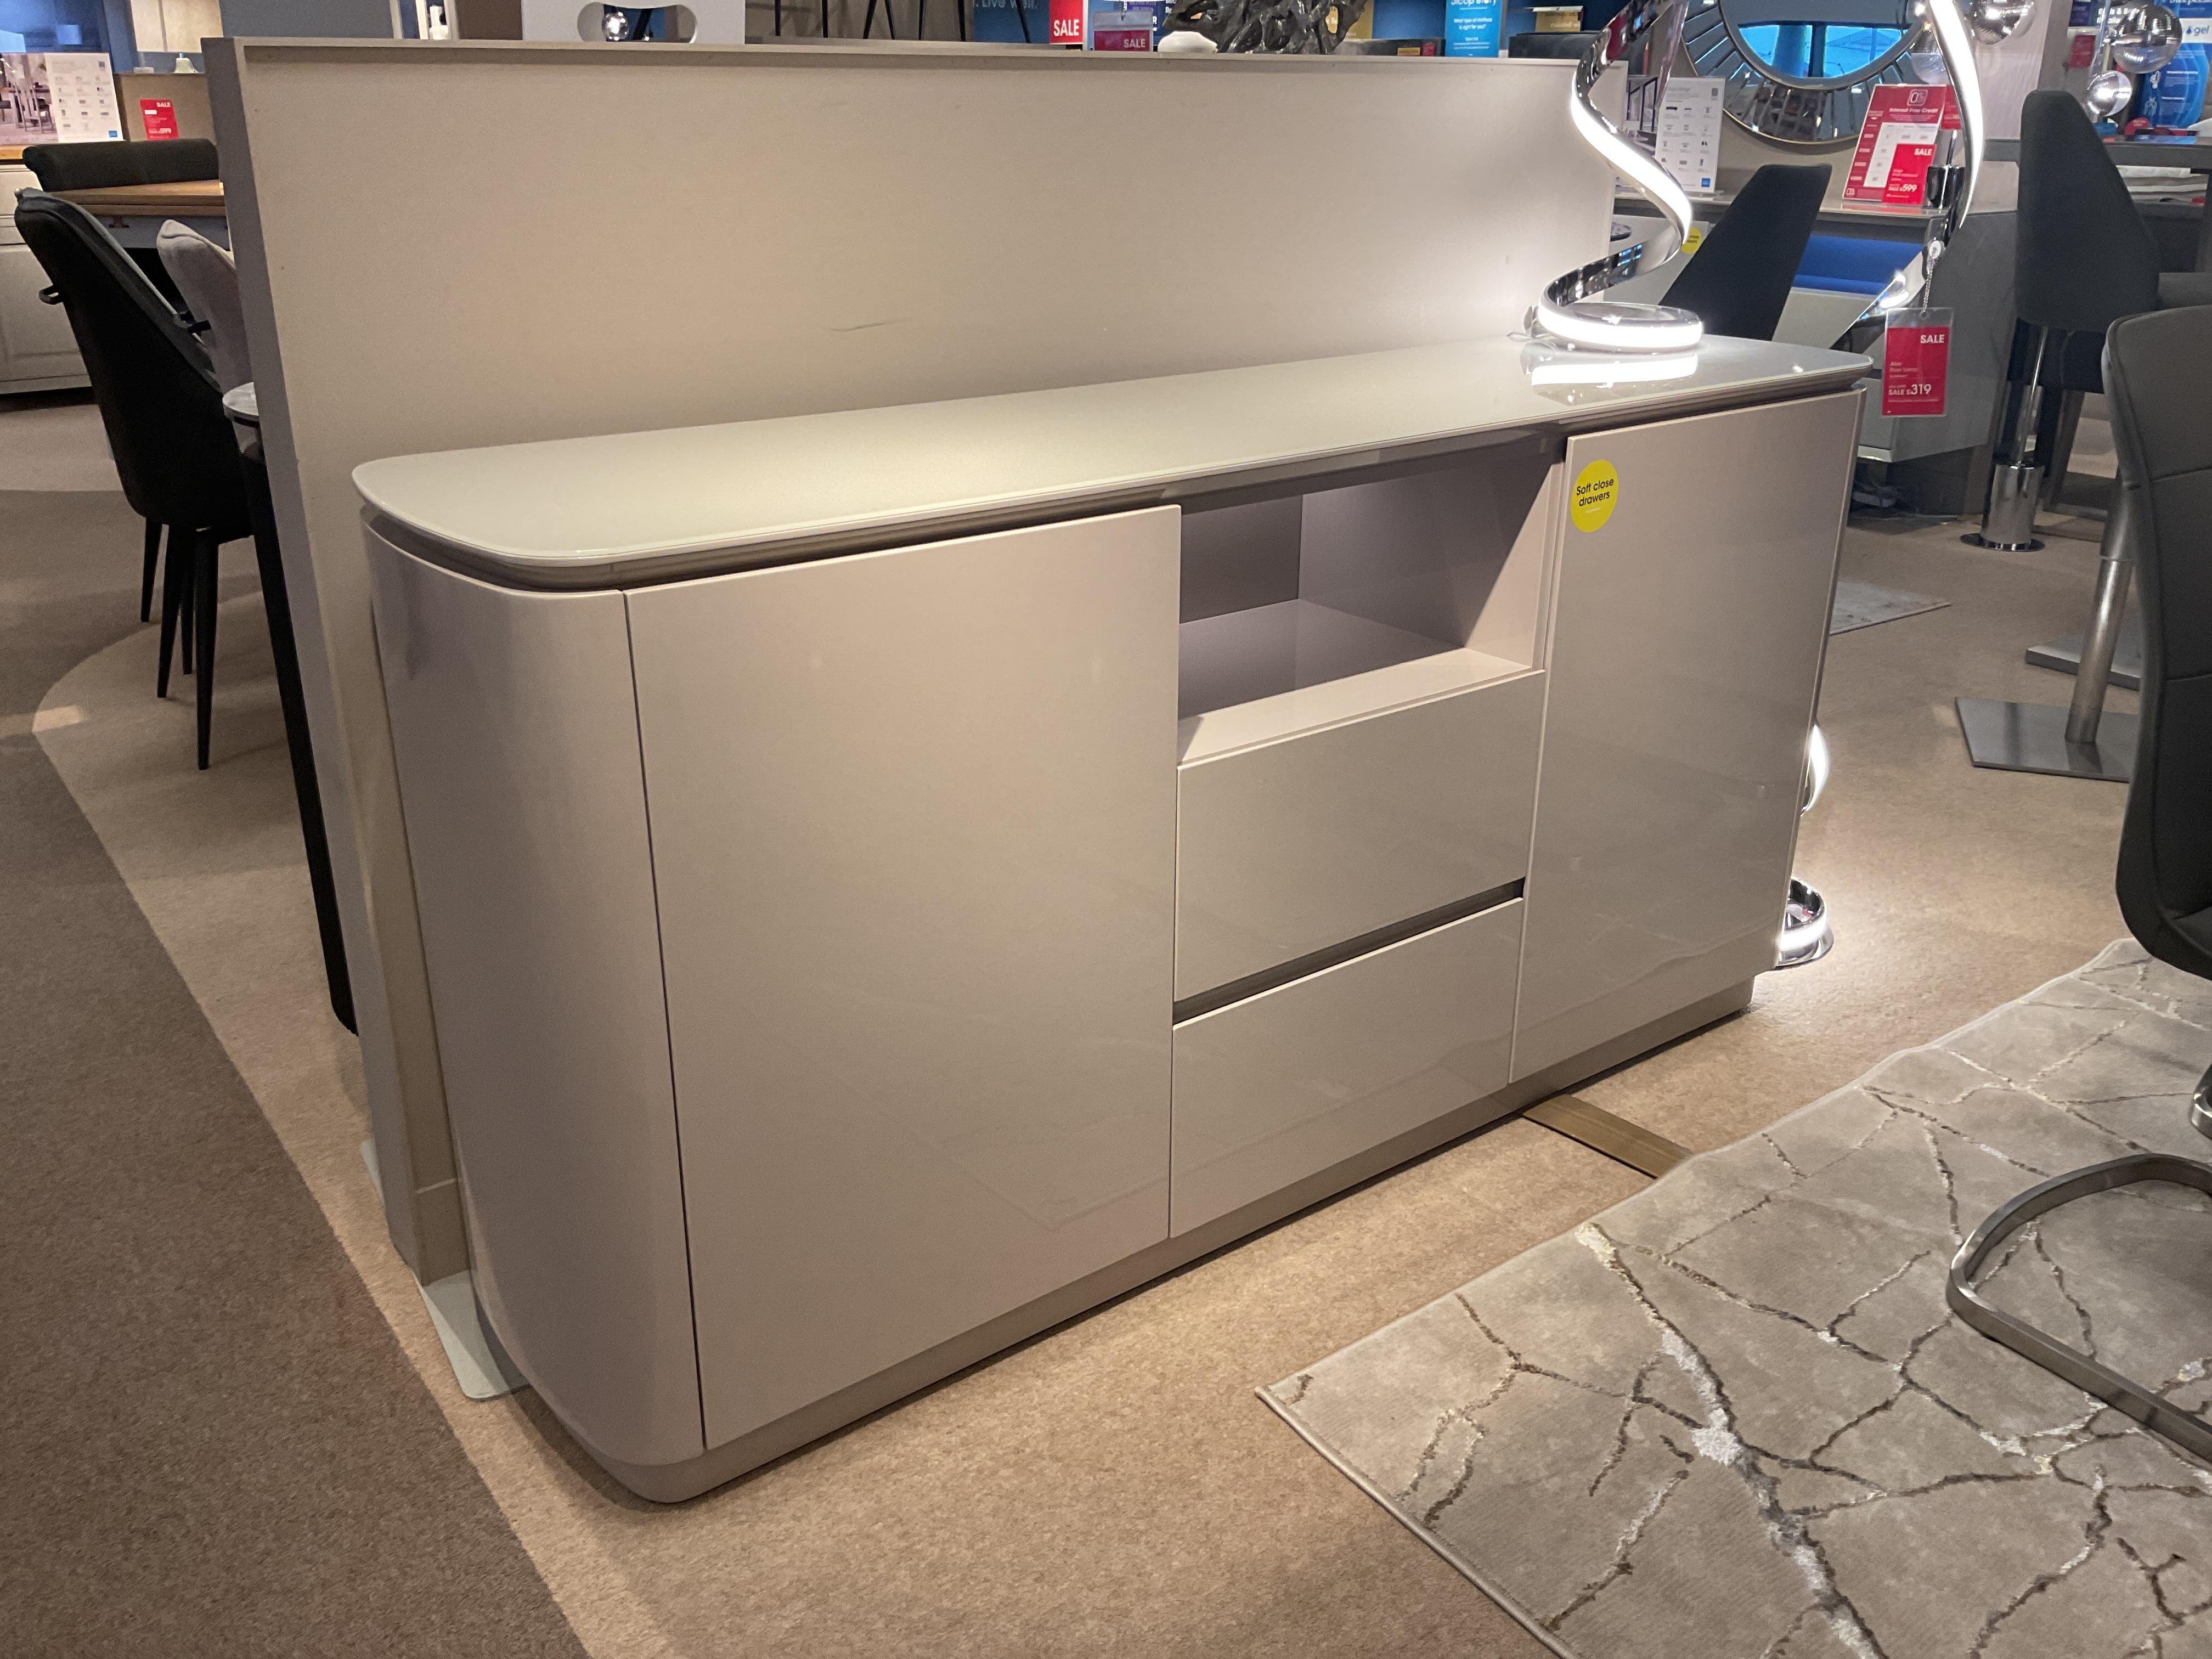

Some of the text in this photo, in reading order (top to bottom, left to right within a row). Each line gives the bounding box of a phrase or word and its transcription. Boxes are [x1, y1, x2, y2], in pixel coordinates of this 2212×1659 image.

[1053, 19, 1079, 37] SALE
[2194, 25, 2209, 36] gel
[1124, 38, 1146, 48] SALE
[1920, 334, 1945, 344] SALE
[1906, 383, 1931, 395] £319
[1577, 479, 1614, 495] Soft close
[1579, 492, 1610, 506] drawers
